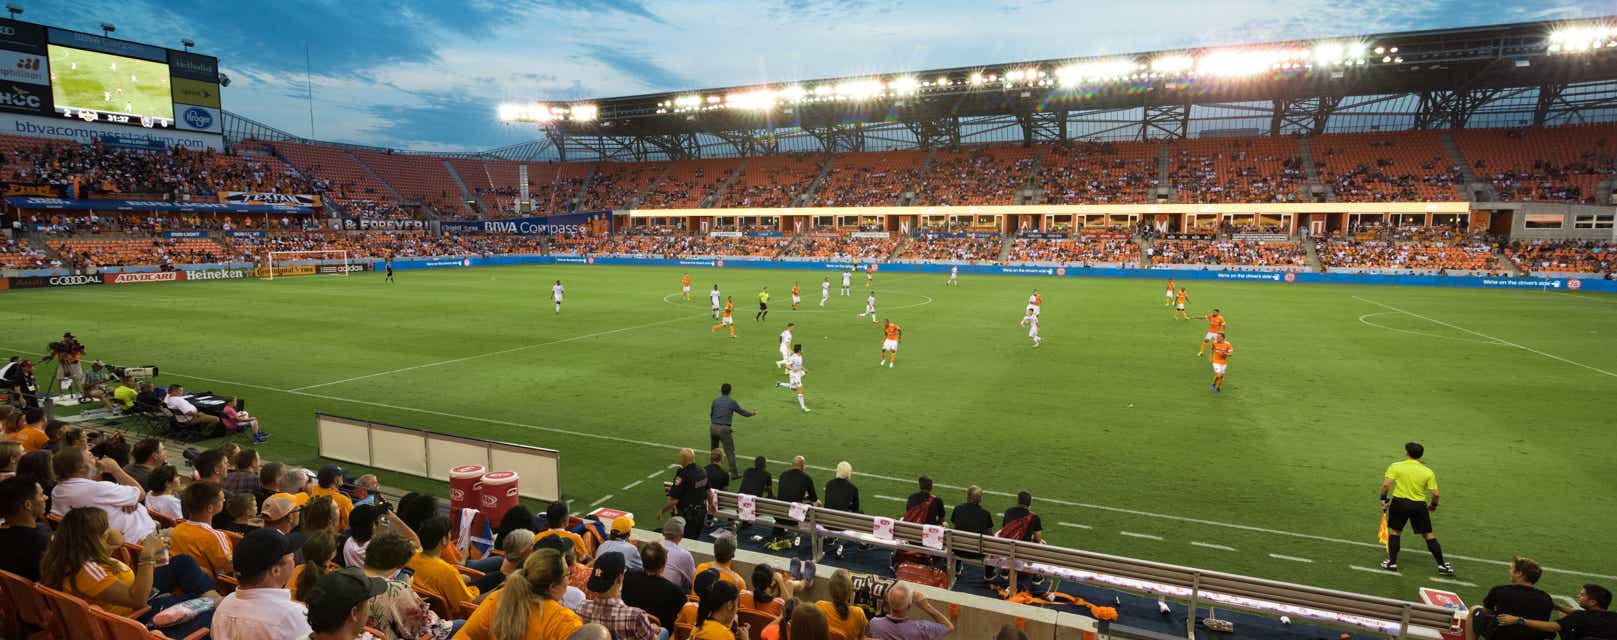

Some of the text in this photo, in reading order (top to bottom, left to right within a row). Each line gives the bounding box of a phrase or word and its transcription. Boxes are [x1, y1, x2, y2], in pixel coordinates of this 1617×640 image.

[63, 108, 72, 118] 2
[185, 110, 211, 128] Kroger
[484, 221, 517, 233] BBVA
[520, 222, 578, 236] Compass
[115, 272, 176, 283] ADVOCARE
[186, 269, 244, 280] Heineken
